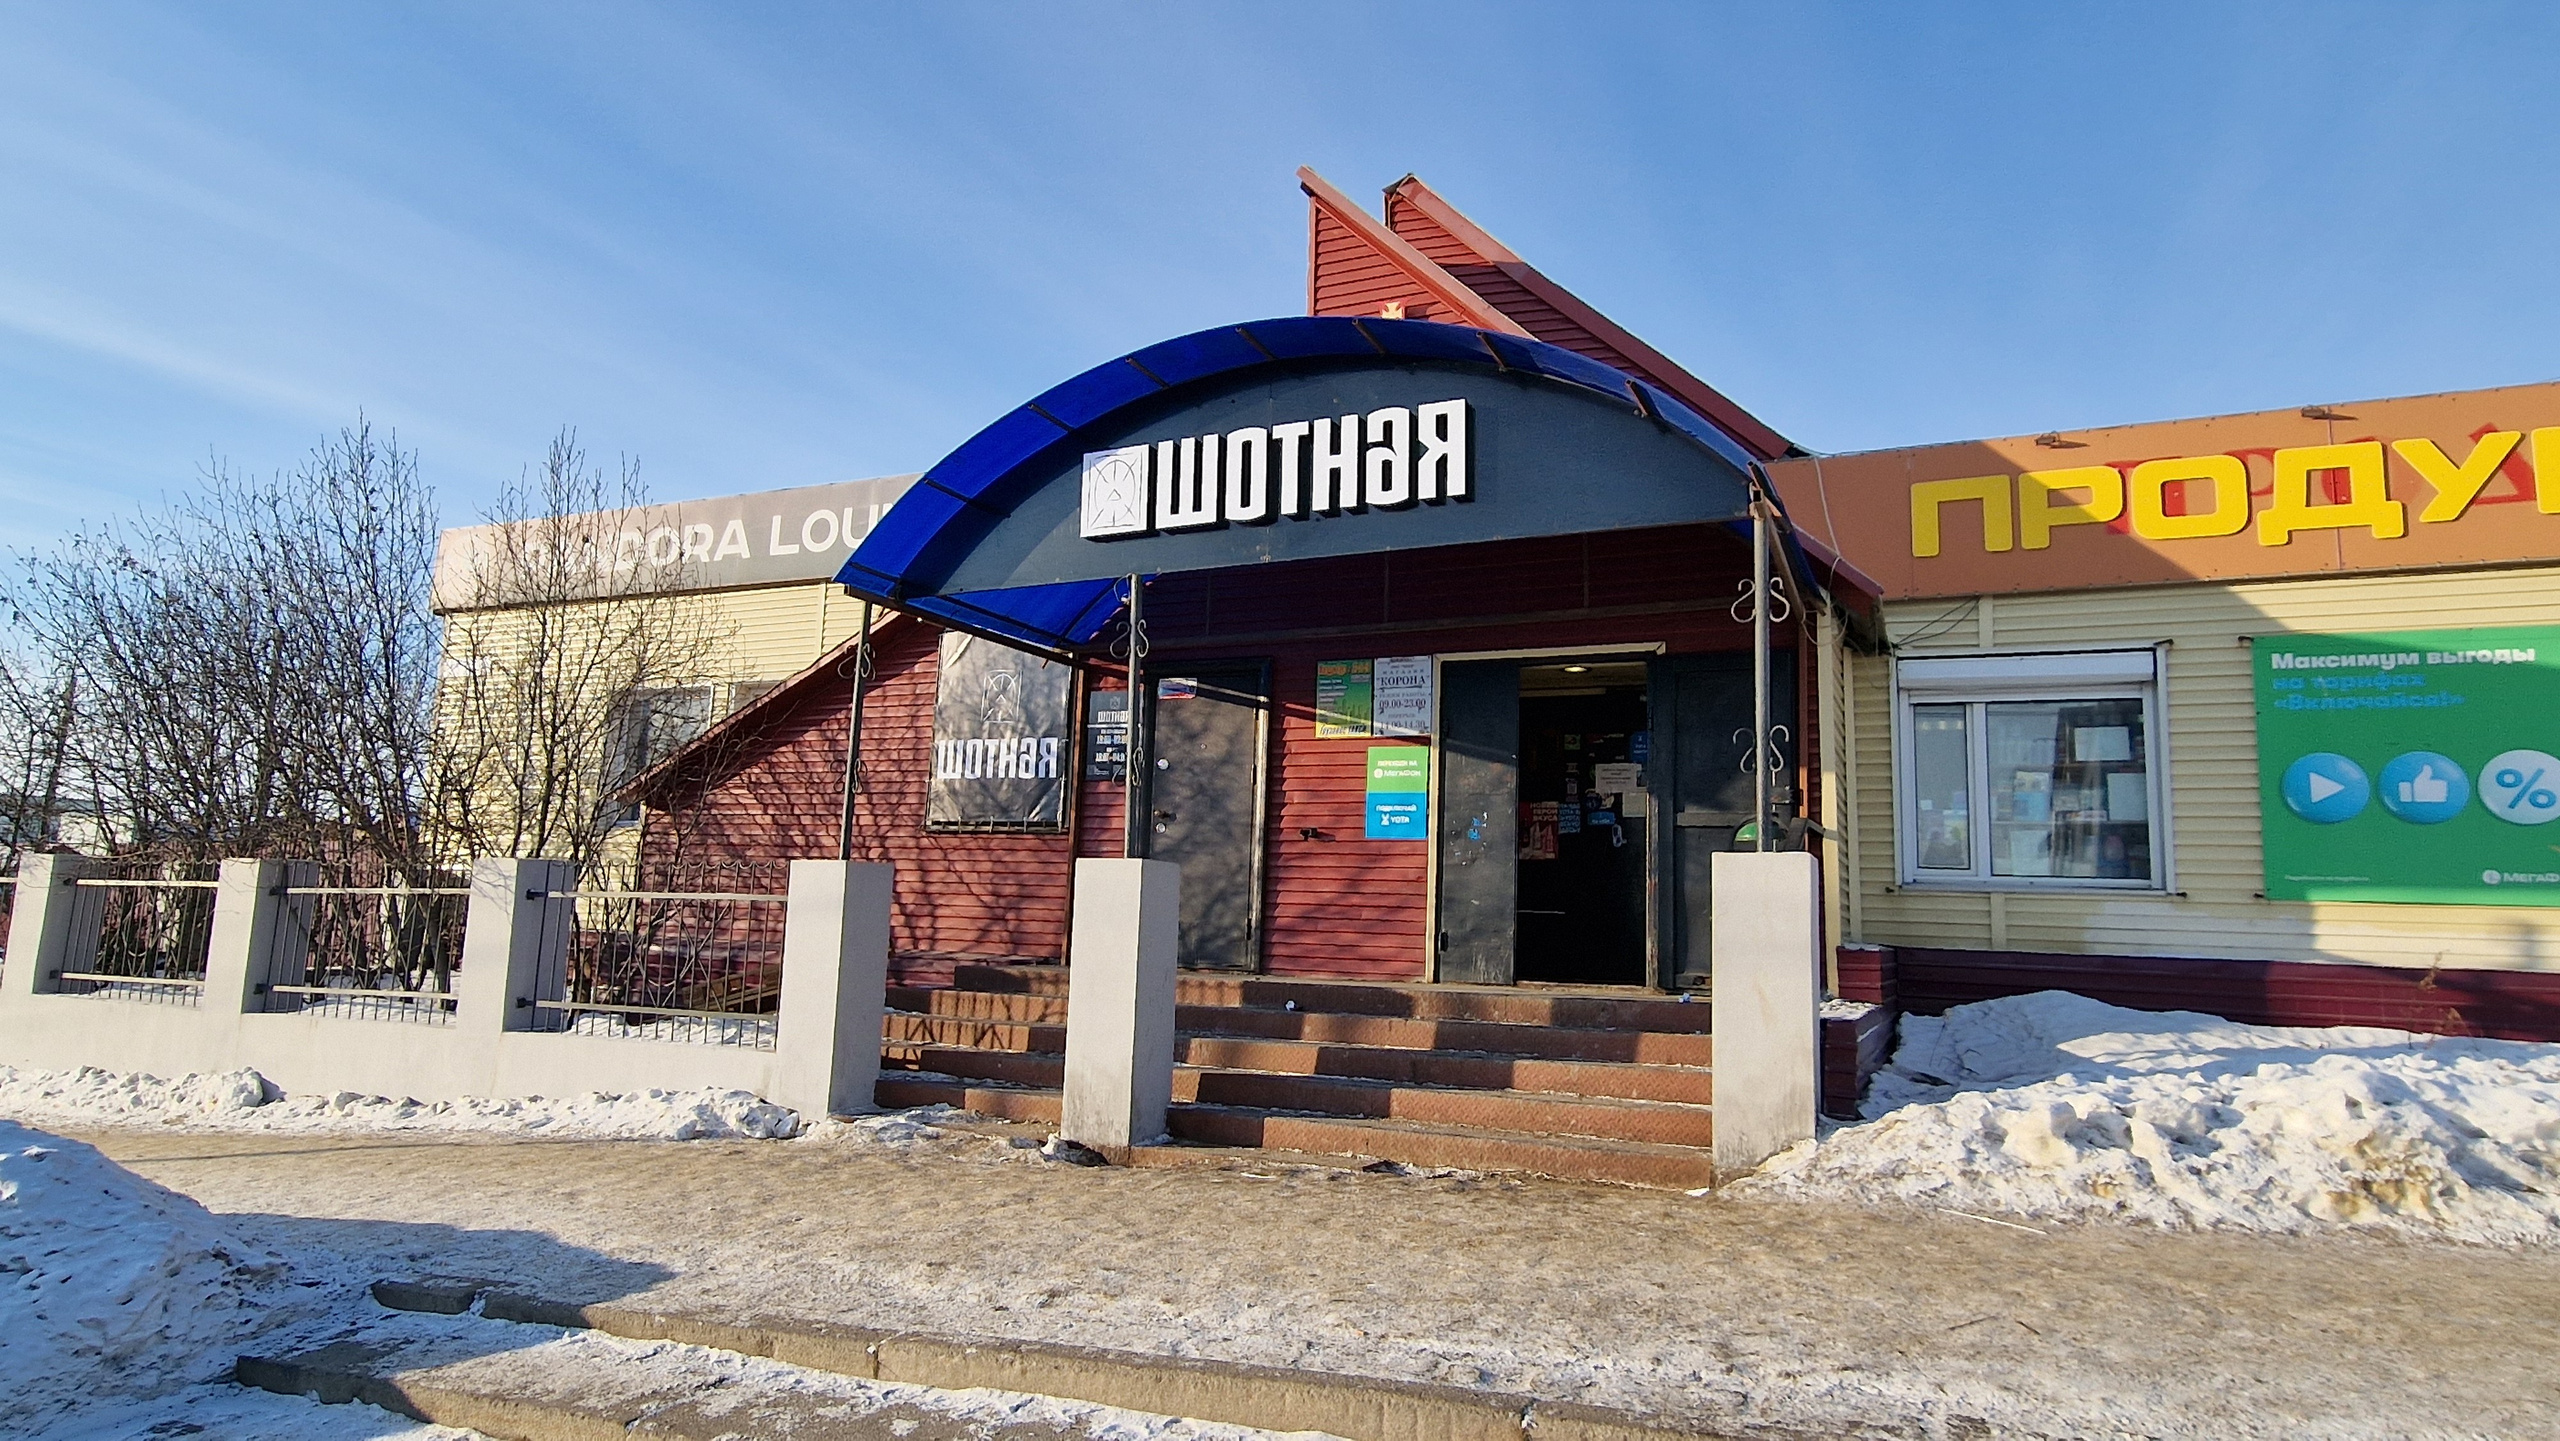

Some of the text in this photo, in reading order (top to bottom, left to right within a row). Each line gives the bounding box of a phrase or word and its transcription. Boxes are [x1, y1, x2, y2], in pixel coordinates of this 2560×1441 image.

[769, 503, 894, 556] LOU
[2271, 649, 2536, 670] Максимум выгоды
[2272, 671, 2427, 691] на тарифах
[1391, 815, 1410, 823] YOTA
